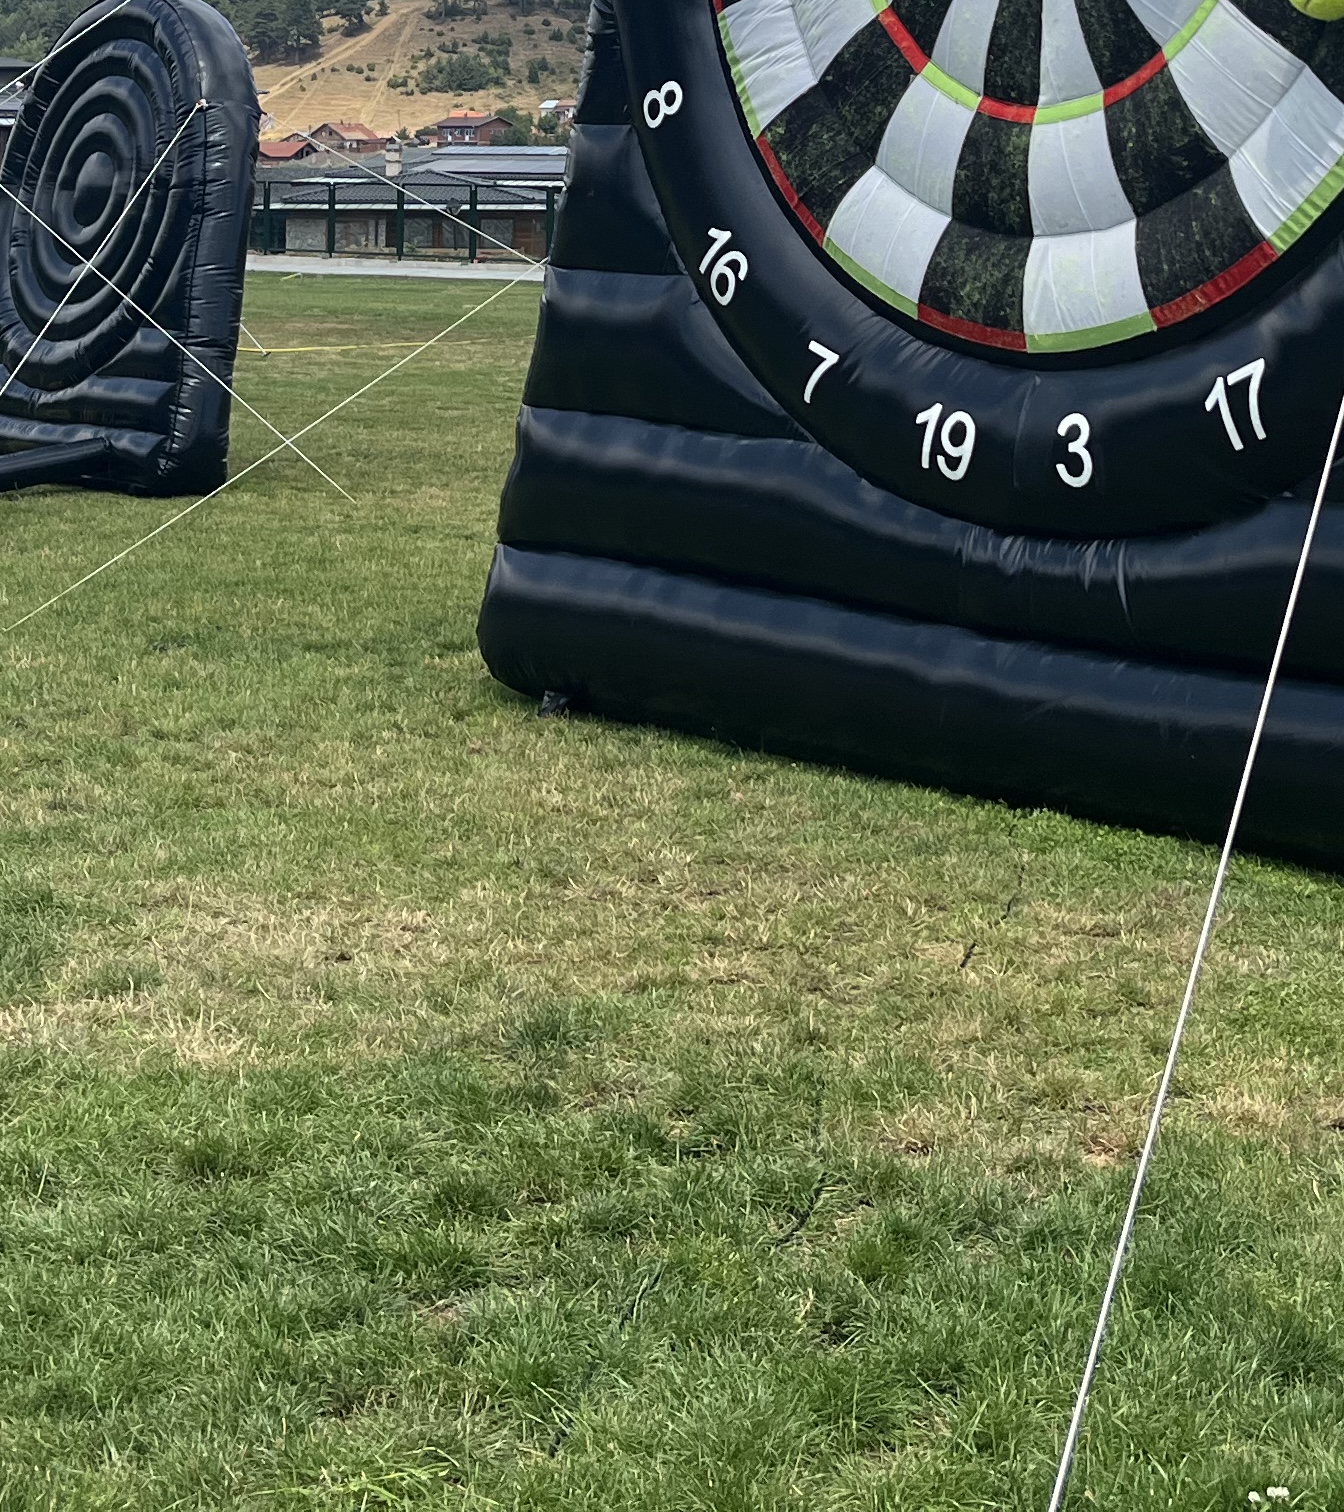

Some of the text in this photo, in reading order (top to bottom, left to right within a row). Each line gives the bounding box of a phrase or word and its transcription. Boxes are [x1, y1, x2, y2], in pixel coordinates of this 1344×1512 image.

[643, 80, 684, 128] 8
[697, 227, 749, 306] 16
[803, 340, 839, 403] 7
[1204, 358, 1267, 451] 17
[915, 402, 976, 481] 19
[1055, 412, 1093, 488] 3
